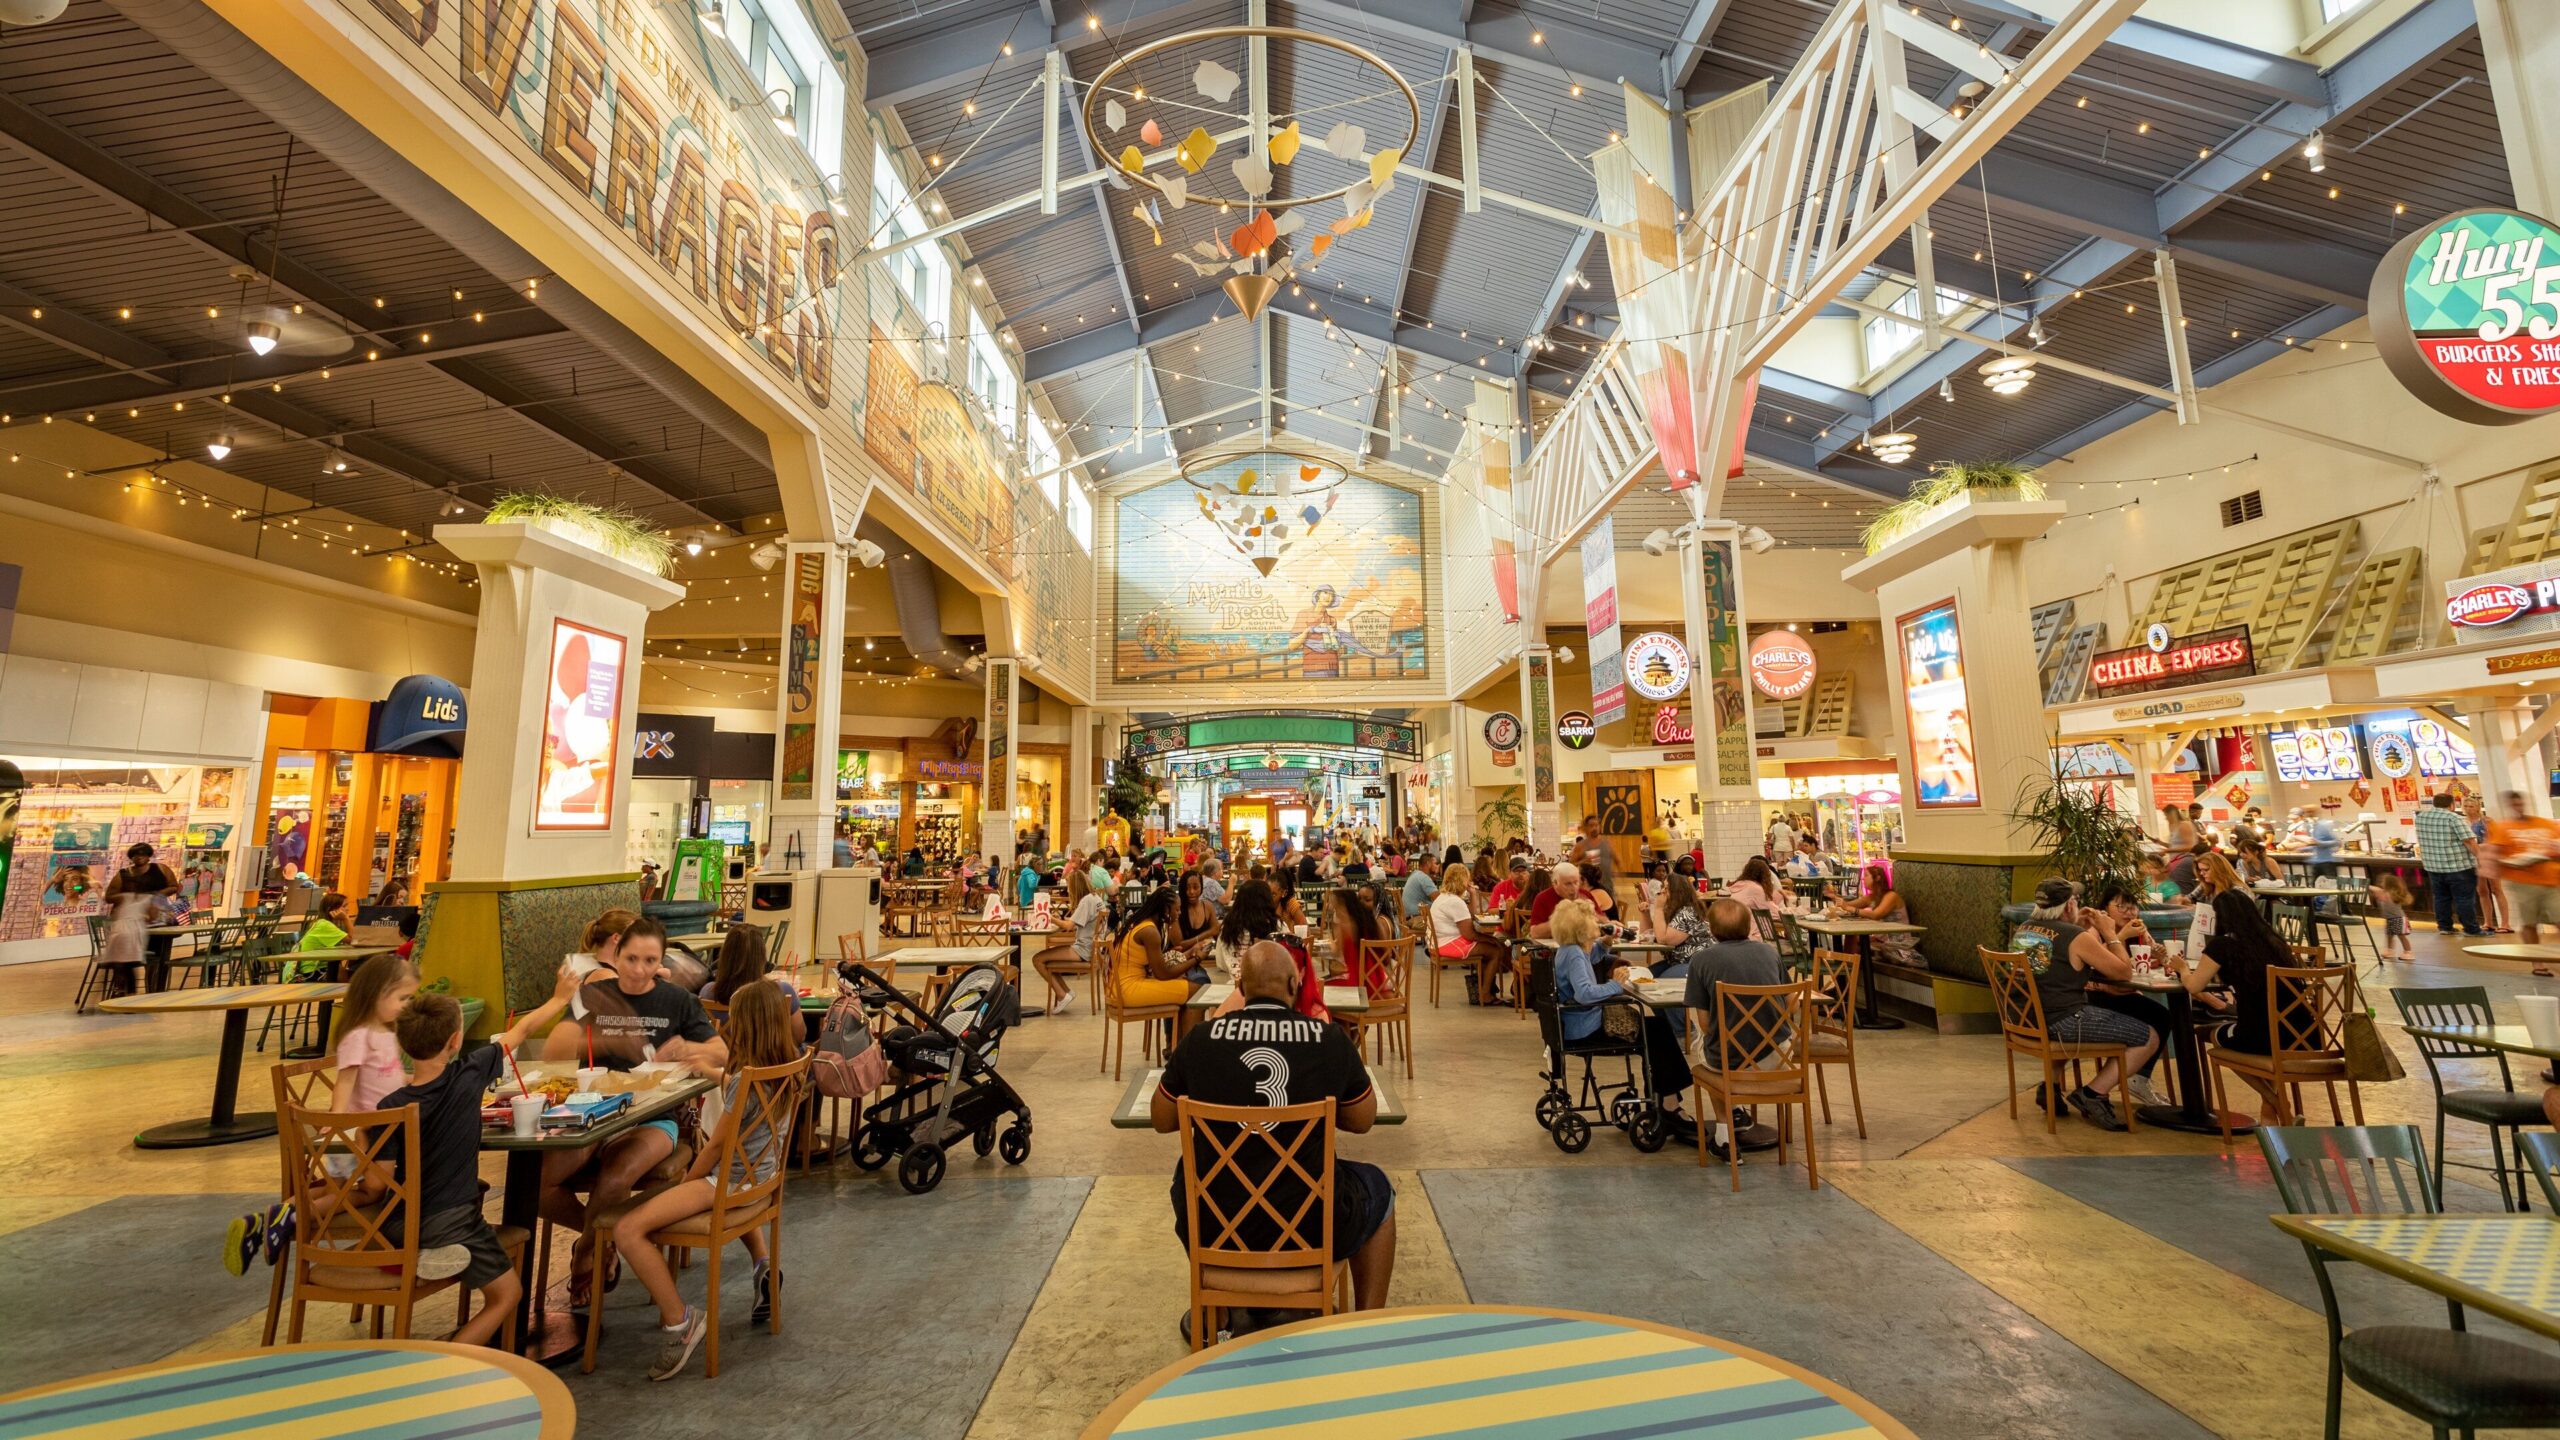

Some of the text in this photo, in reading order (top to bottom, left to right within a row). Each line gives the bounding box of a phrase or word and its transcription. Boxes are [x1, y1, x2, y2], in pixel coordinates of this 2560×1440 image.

[597, 0, 745, 181] RDWALK
[366, 0, 838, 410] VERAGES
[2428, 228, 2544, 286] Hwy
[2478, 265, 2560, 342] 55
[2435, 344, 2522, 363] BURGERS
[2486, 367, 2503, 386] &
[1187, 578, 1264, 613] Myrtle
[1703, 554, 1720, 640] COLD!
[2447, 589, 2530, 621] CHARLEYS
[1222, 600, 1289, 629] Beach
[806, 639, 819, 658] 2
[1629, 636, 1687, 671] CHINA EXPRESS
[1752, 652, 1811, 668] CHARLEYS
[2093, 638, 2244, 684] CHINA EXPRESS
[1634, 676, 1685, 696] Chinese Food
[1754, 670, 1813, 695] PHILLY STEAKS
[422, 696, 459, 722] Lids
[1535, 681, 1549, 735] SURFSIDE
[2143, 701, 2183, 716] GLAD
[1559, 727, 1594, 736] SBARRO
[1408, 773, 1428, 788] H&M
[44, 905, 97, 915] PIERCED FREE
[1210, 1018, 1323, 1043] GERMANY
[1239, 1047, 1290, 1133] 3
